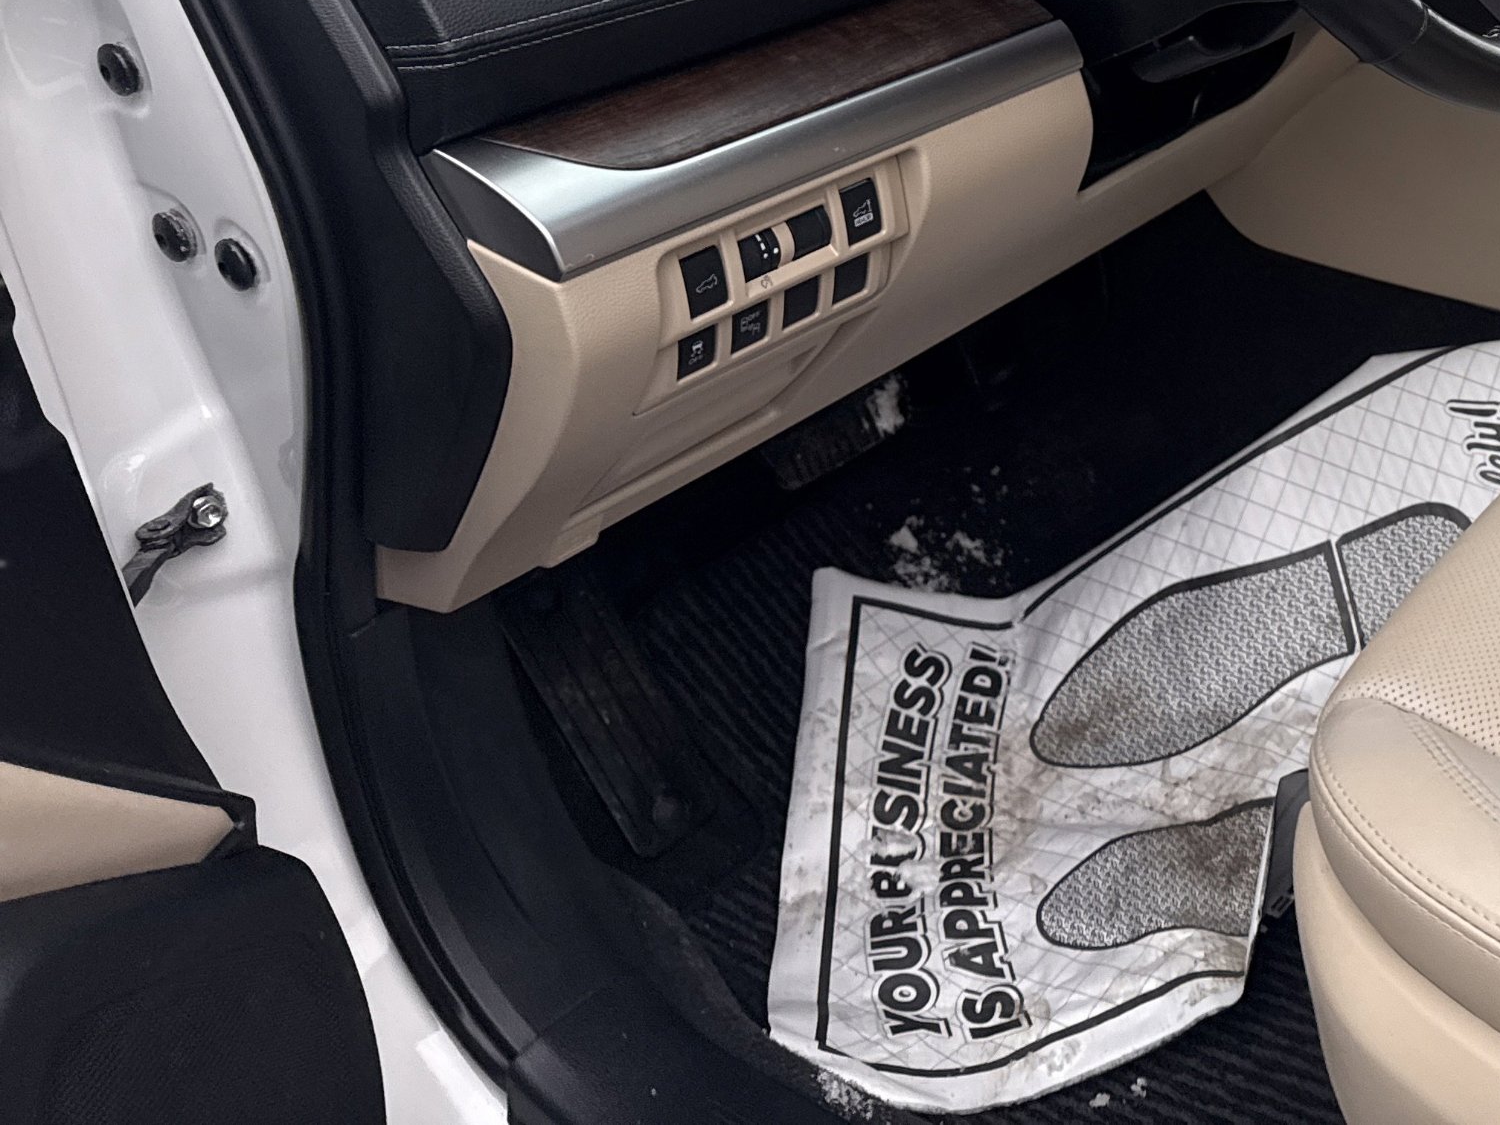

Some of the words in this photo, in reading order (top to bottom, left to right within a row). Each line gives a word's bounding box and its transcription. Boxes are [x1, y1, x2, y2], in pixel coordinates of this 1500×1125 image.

[870, 645, 950, 899] BUSINESS
[938, 644, 1012, 980] APPRECIATED!
[870, 897, 950, 1038] YOUR
[960, 984, 1028, 1041] IS
